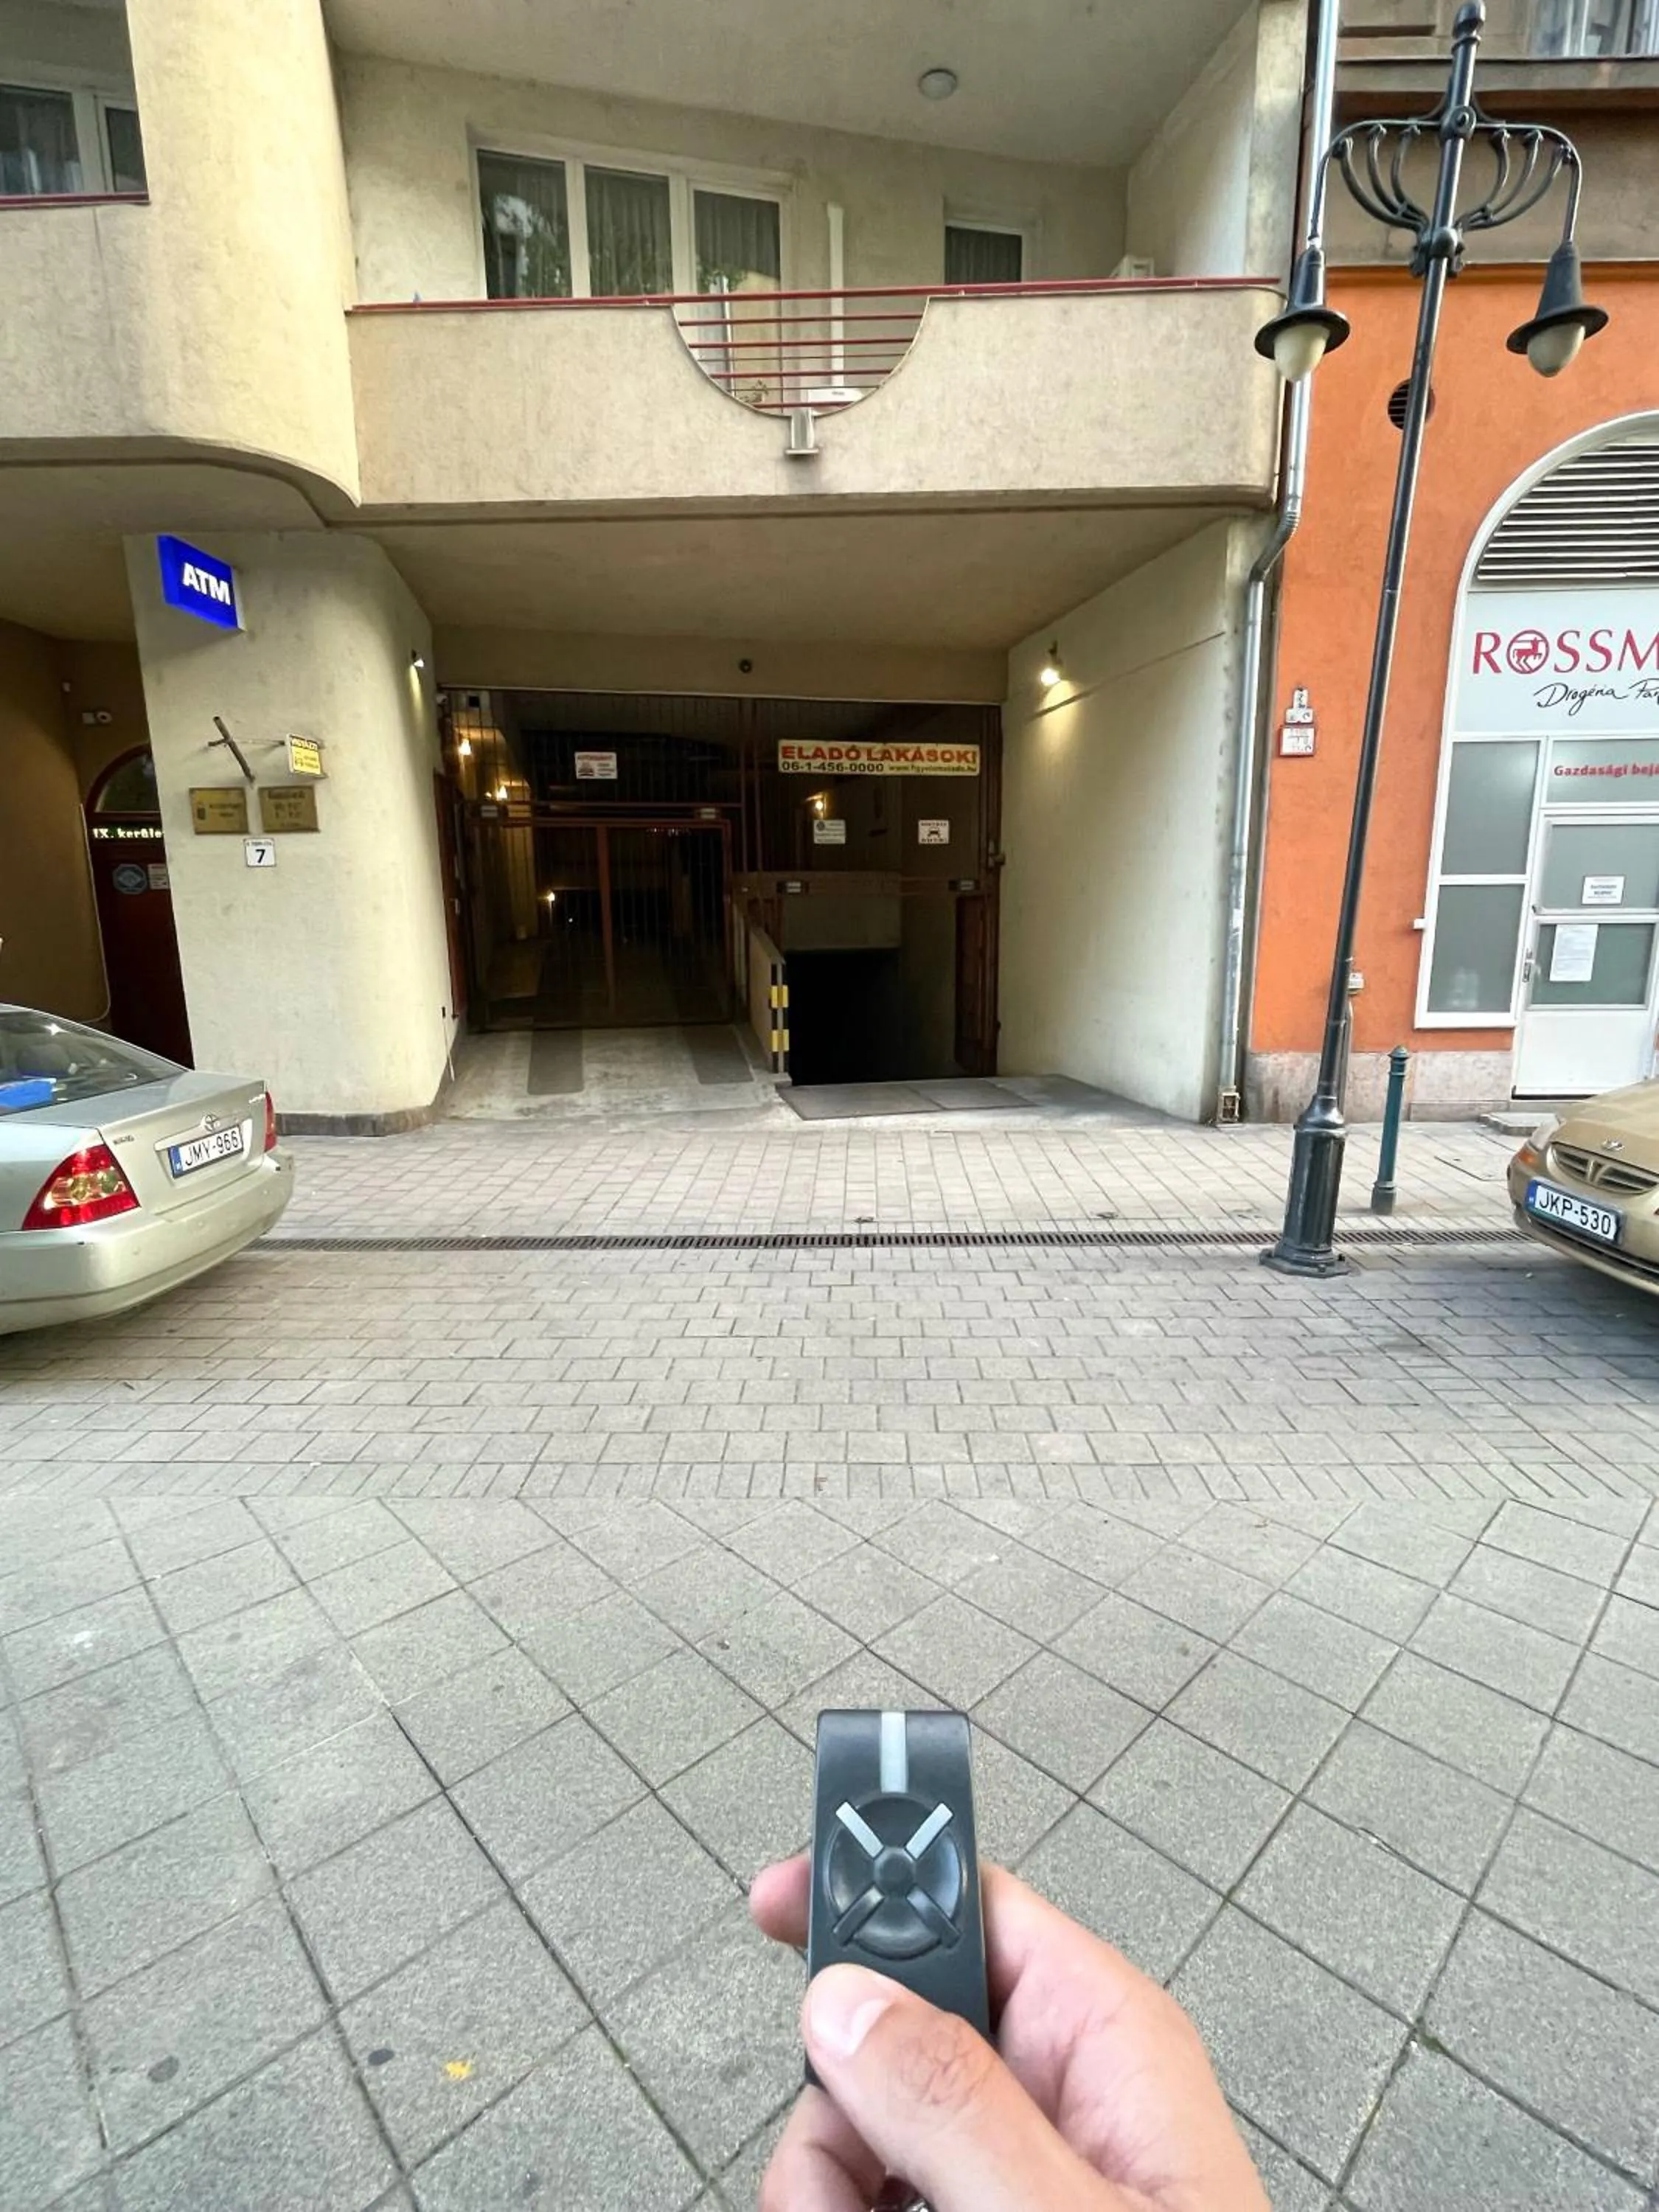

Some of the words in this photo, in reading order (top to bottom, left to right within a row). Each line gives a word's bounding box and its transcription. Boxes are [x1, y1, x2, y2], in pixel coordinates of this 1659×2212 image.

[182, 561, 231, 605] ATM
[1534, 682, 1629, 716] Drogéria
[781, 744, 862, 761] ELADÓ
[782, 761, 884, 773] 06-1-456-0000
[1554, 764, 1627, 777] Gazdasági
[255, 849, 265, 863] 7
[185, 1130, 239, 1166] JMY-966
[1539, 1191, 1611, 1235] JKP-530
